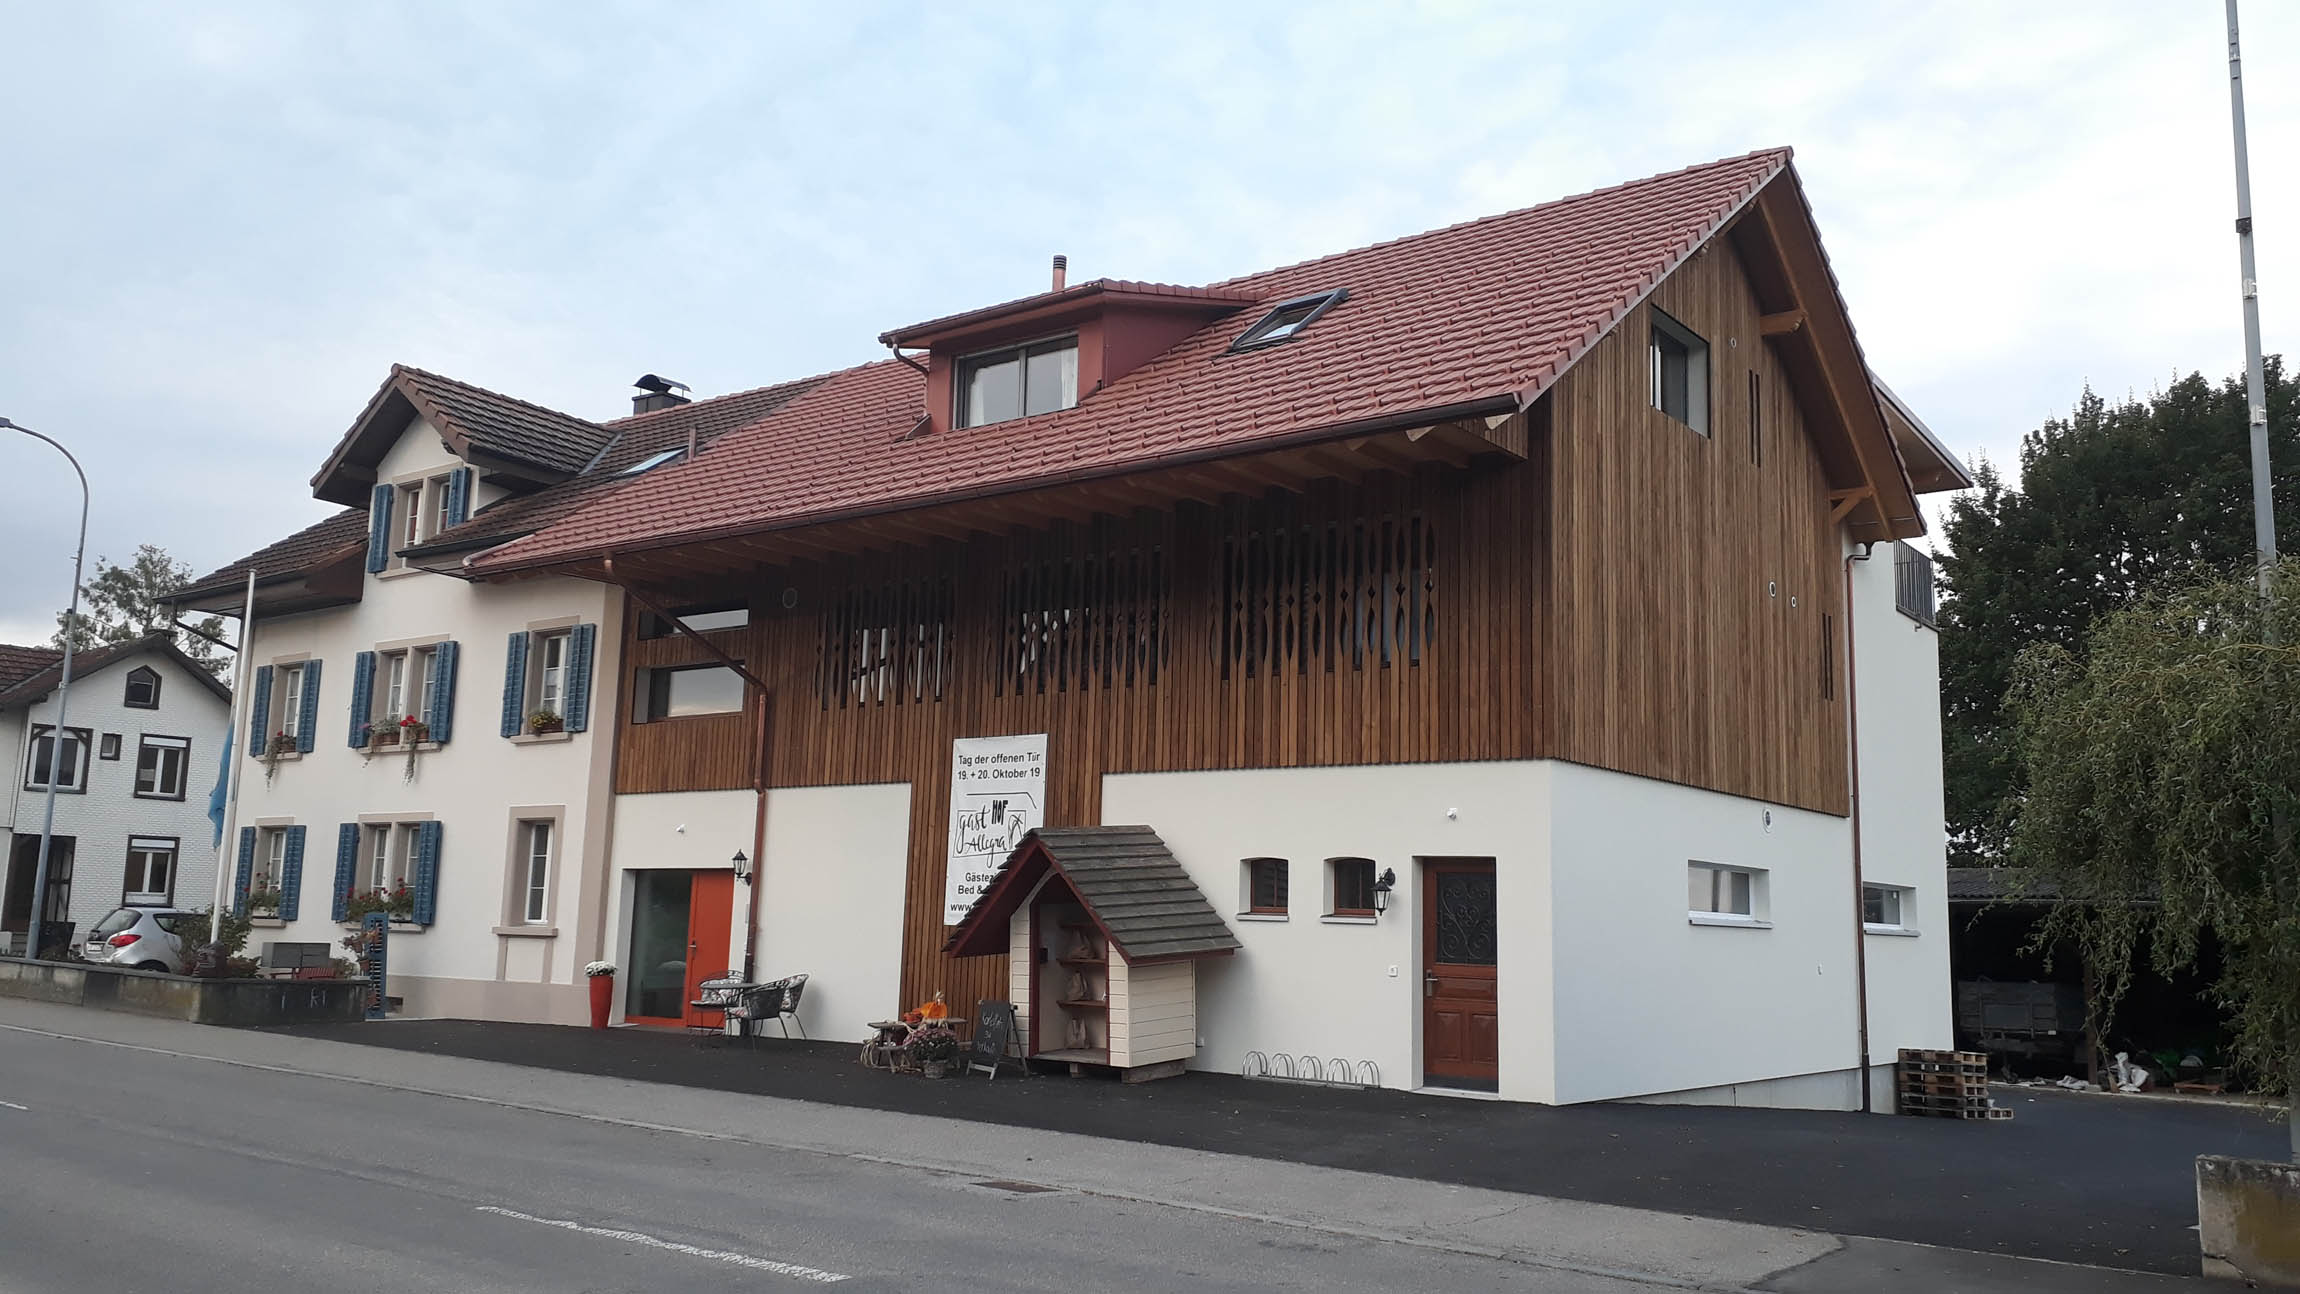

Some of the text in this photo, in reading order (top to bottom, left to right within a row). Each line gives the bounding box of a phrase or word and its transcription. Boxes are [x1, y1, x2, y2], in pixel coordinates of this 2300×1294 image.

[958, 751, 1041, 767] Tag der offenen Tür
[958, 770, 969, 780] 19.
[977, 769, 991, 780] 20.
[992, 768, 1028, 779] Oktober
[1030, 767, 1041, 777] 19
[991, 799, 1009, 825] HOF
[964, 833, 1008, 868] Allegra
[957, 884, 975, 895] Bed
